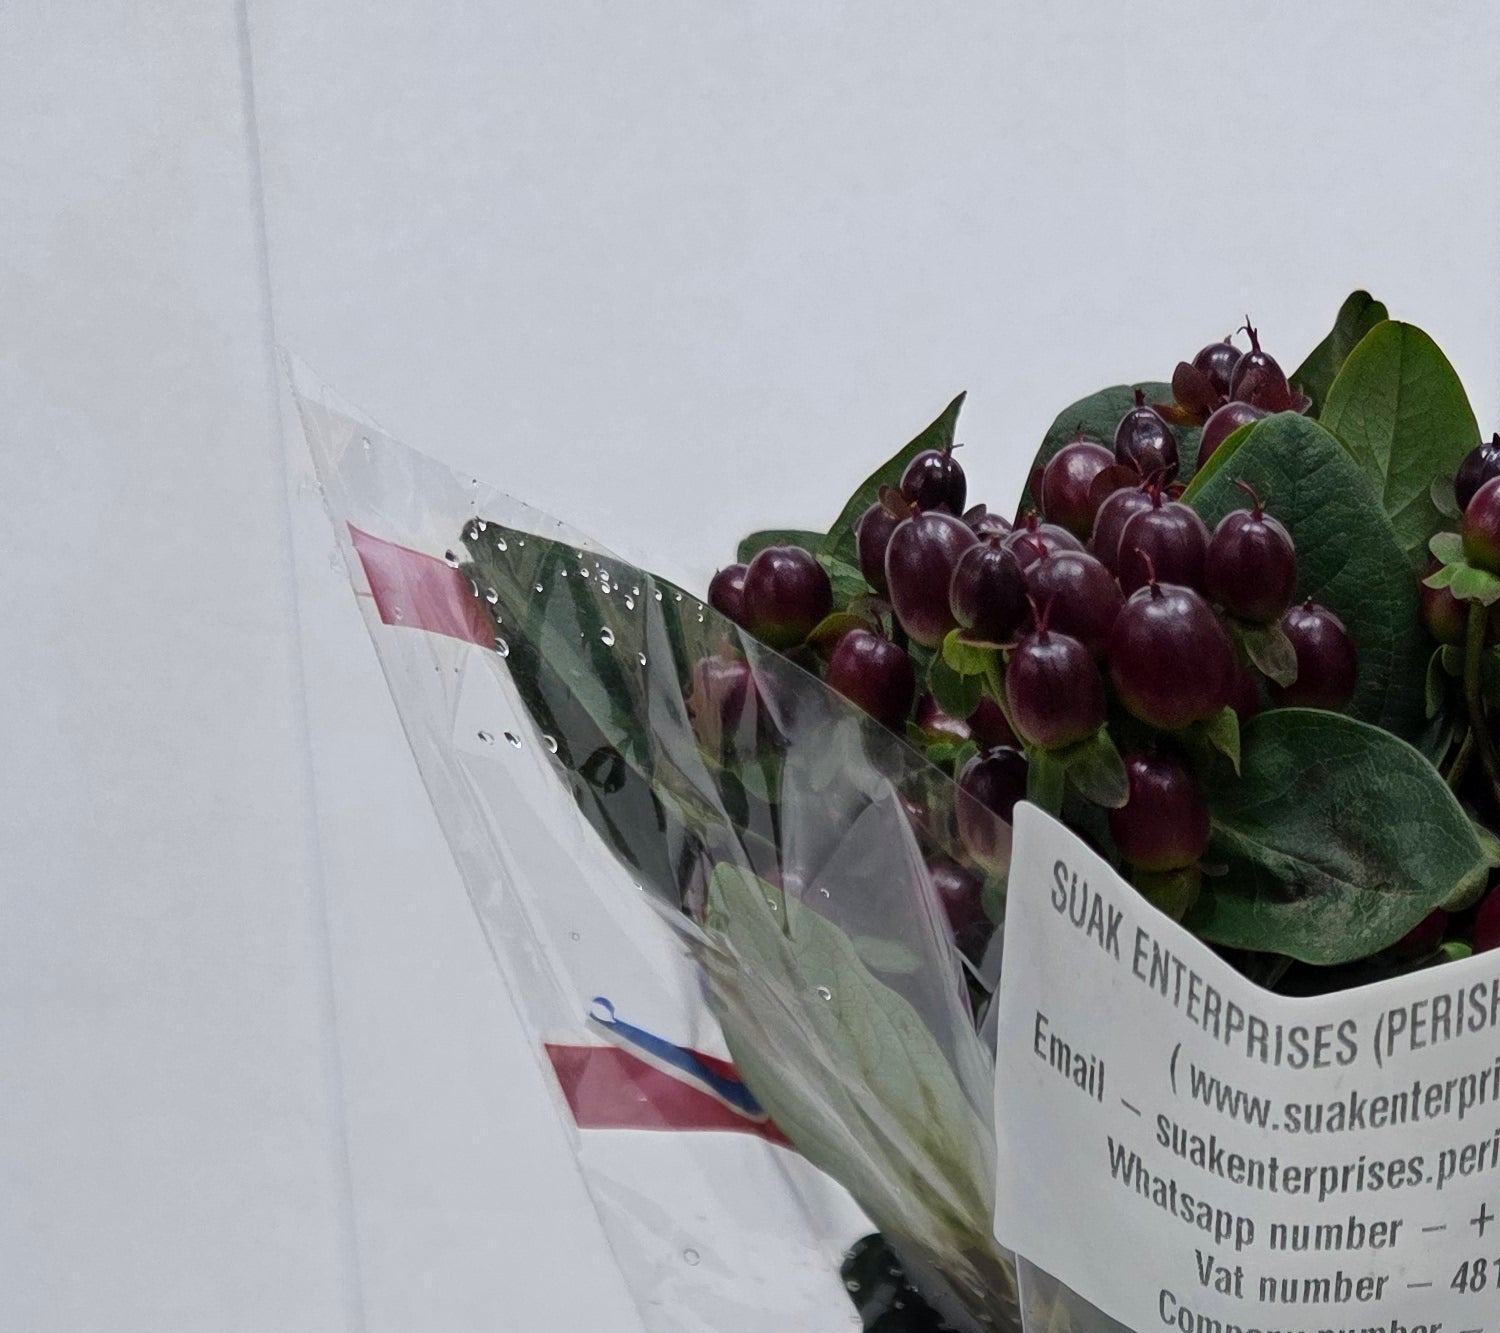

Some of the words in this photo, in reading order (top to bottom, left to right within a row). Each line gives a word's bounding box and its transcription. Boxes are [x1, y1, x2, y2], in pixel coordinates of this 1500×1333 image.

[1051, 860, 1124, 961] SUAK
[1132, 926, 1358, 1070] ENTERPRISES
[1033, 1010, 1105, 1103] Email
[1107, 1135, 1255, 1252] Whatsapp
[1269, 1215, 1403, 1251] number
[1194, 1249, 1244, 1300] Vat
[1259, 1271, 1389, 1304] number
